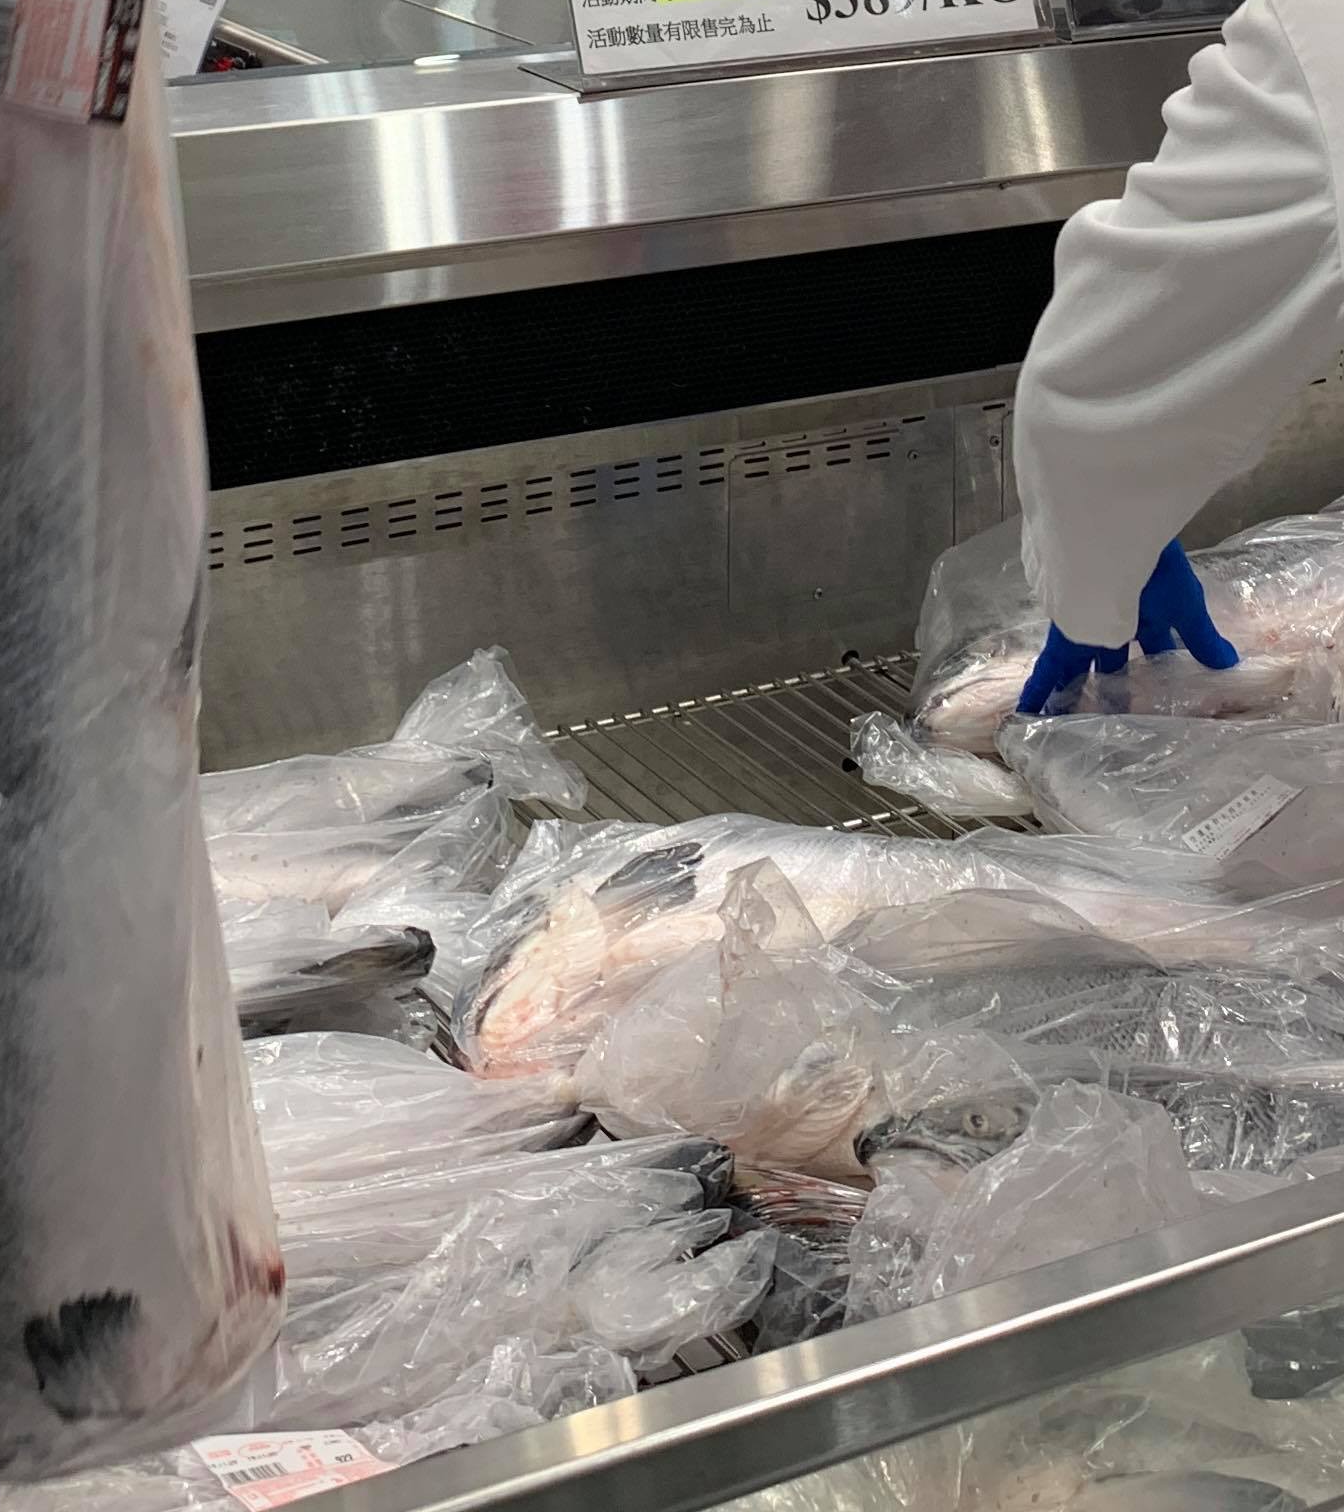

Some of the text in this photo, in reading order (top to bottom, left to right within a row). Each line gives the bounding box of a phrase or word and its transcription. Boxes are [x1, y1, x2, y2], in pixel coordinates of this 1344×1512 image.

[587, 13, 775, 49] 活動數量有限售完為止
